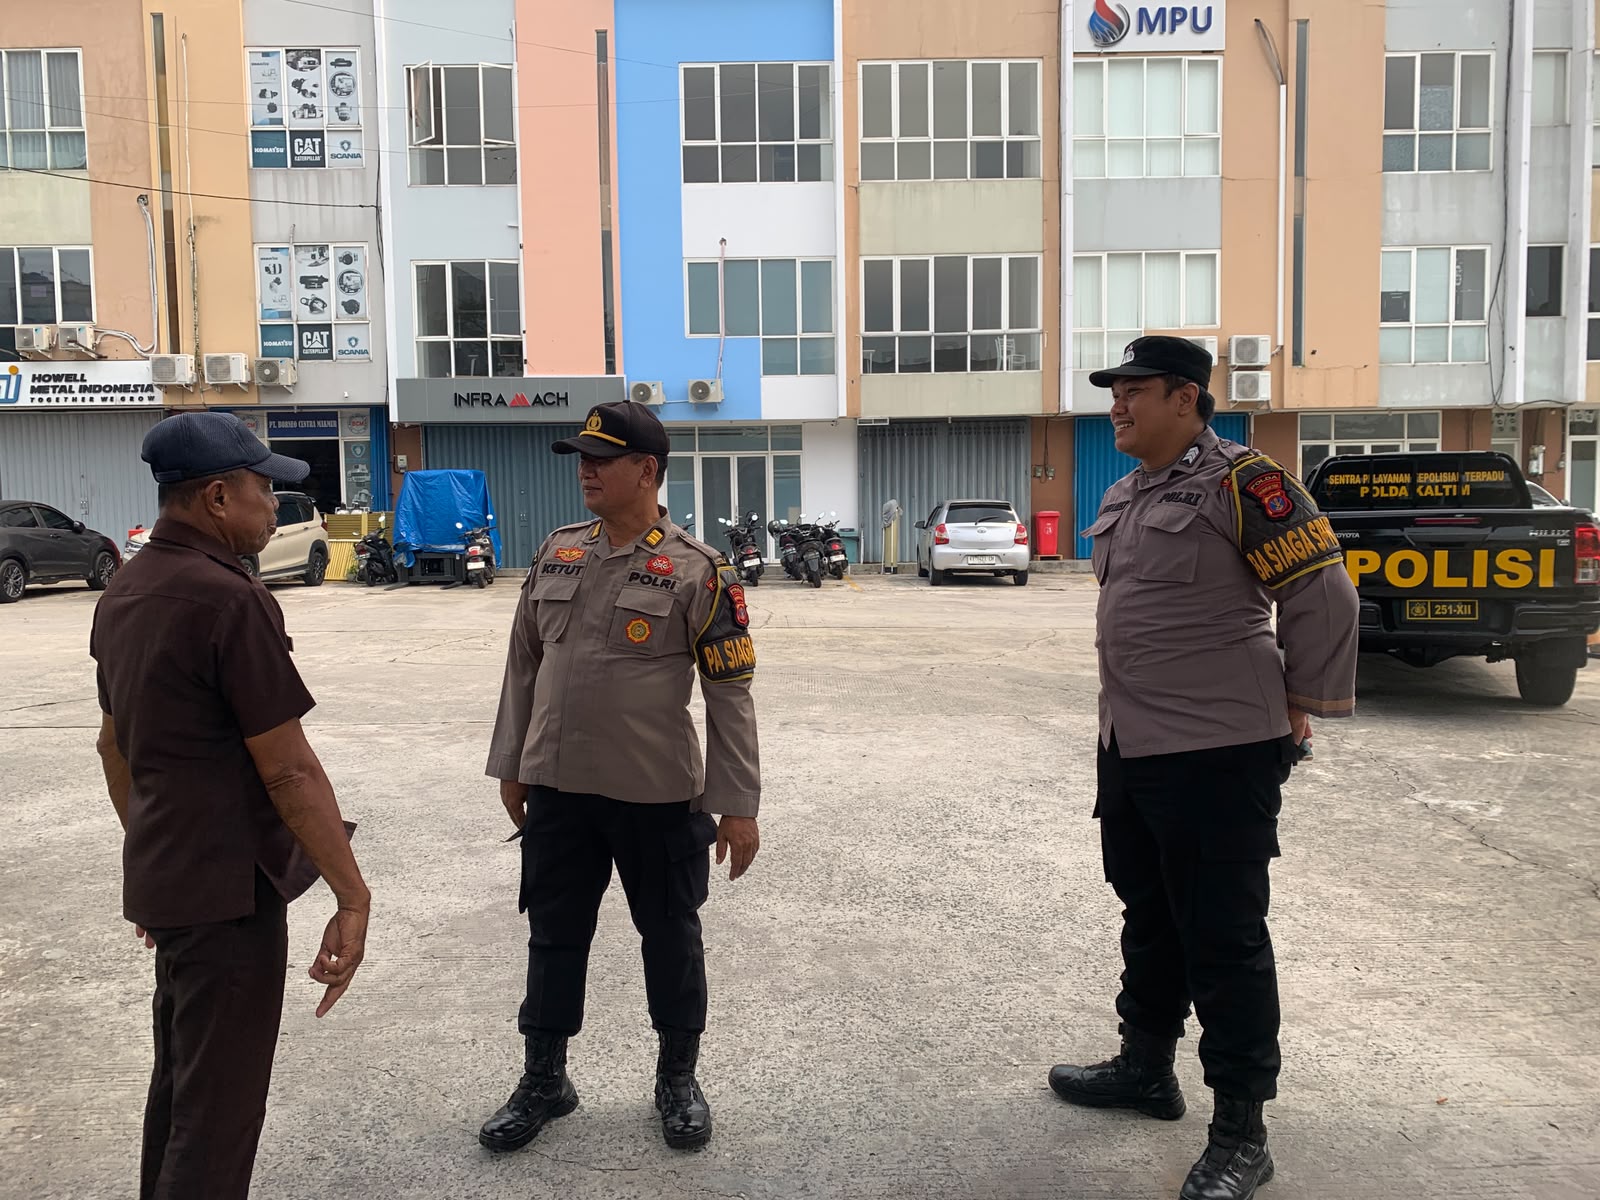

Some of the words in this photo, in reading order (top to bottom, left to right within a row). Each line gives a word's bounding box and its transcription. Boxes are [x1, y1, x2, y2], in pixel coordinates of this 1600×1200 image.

[1137, 6, 1213, 34] MPU
[294, 138, 321, 155] CAT
[302, 331, 329, 348] CAT
[31, 373, 87, 383] HOWELL
[30, 385, 75, 394] METAL
[78, 384, 154, 394] INDONESIA
[1329, 474, 1361, 485] SENTRA
[1465, 471, 1504, 482] TERPADU
[1263, 526, 1318, 572] SIAGA
[541, 563, 584, 576] KETUT
[1346, 549, 1555, 588] POLISI
[628, 571, 677, 590] POLRI
[1434, 604, 1472, 615] 251-XII
[703, 643, 725, 675] PA
